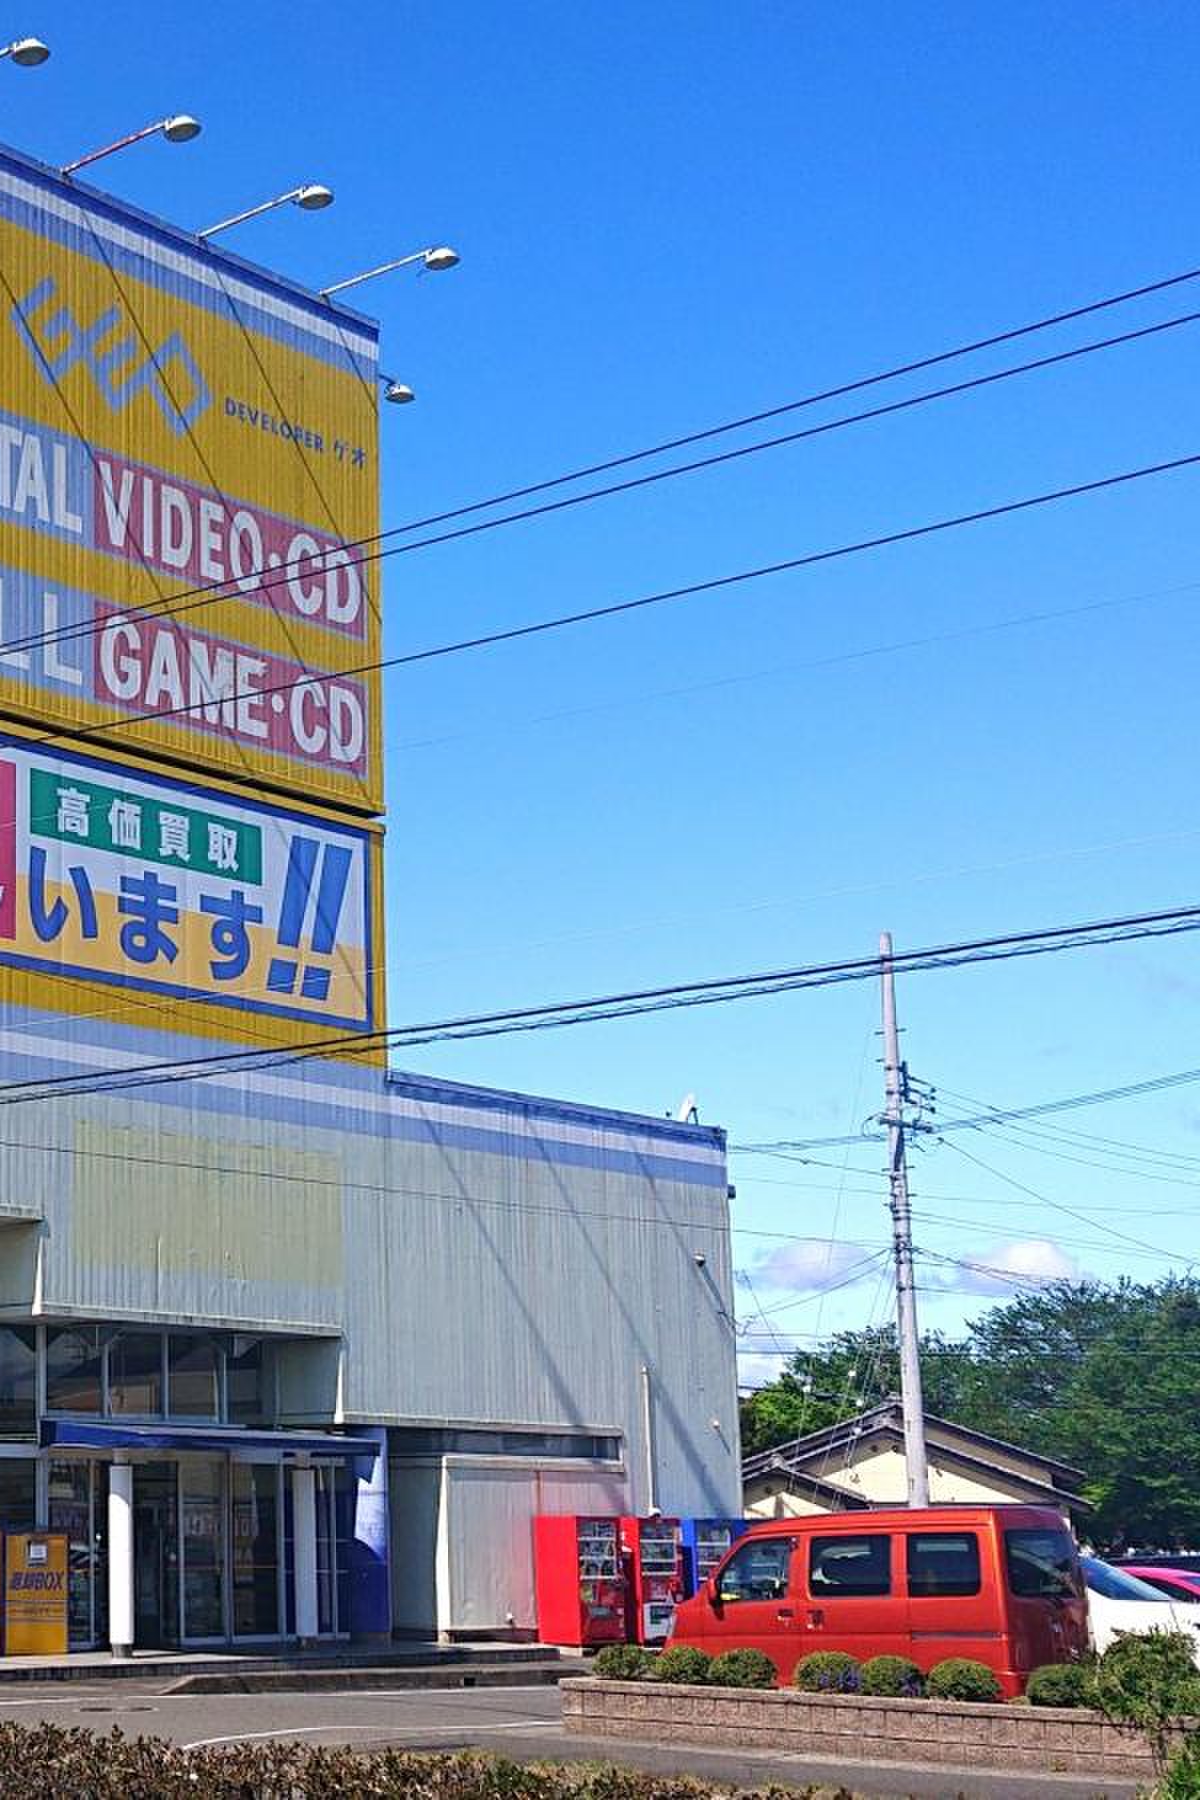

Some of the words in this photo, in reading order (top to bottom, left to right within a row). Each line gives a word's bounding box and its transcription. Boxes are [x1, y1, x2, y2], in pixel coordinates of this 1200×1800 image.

[225, 396, 323, 453] DEVELOPER
[57, 787, 239, 872] 高価買取
